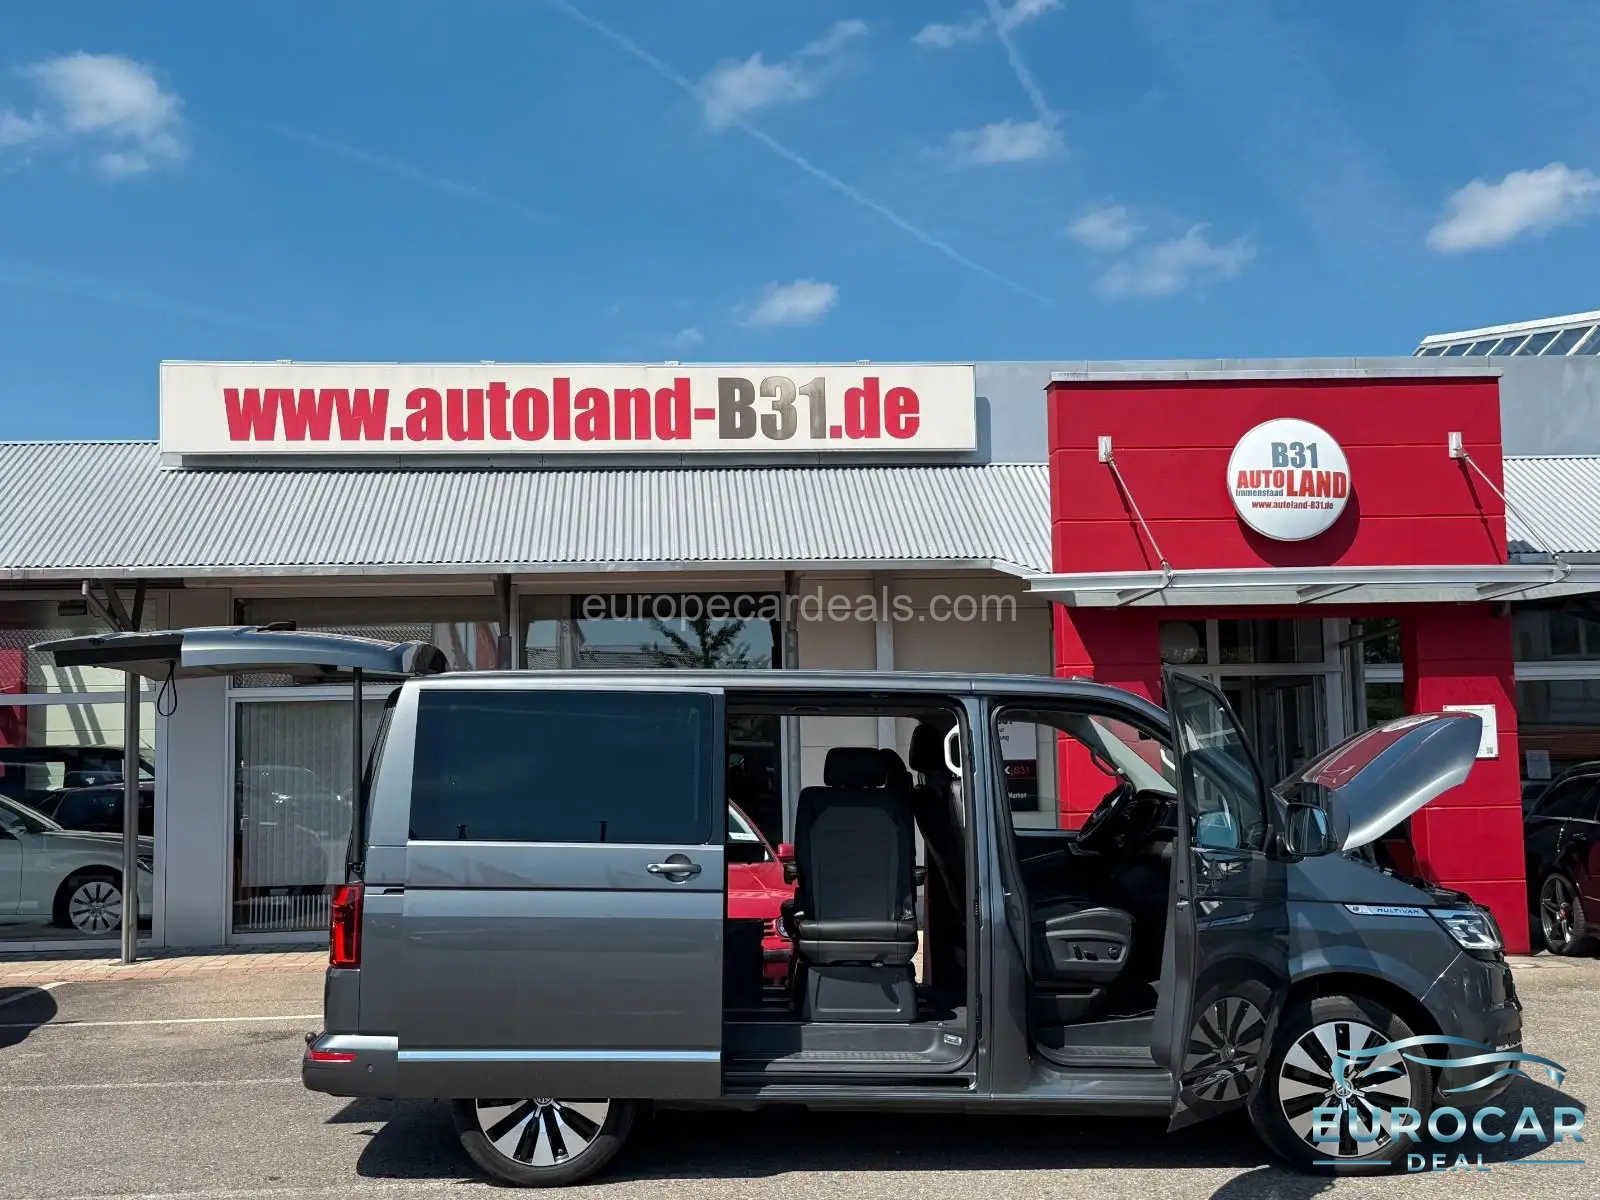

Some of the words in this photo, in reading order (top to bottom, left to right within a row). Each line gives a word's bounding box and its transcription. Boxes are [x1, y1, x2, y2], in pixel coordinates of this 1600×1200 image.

[223, 376, 920, 442] www.autoland-B31.de
[1271, 441, 1318, 468] B31
[1235, 488, 1284, 497] Immenstaad
[1251, 500, 1334, 510] www.autoland-B31.de
